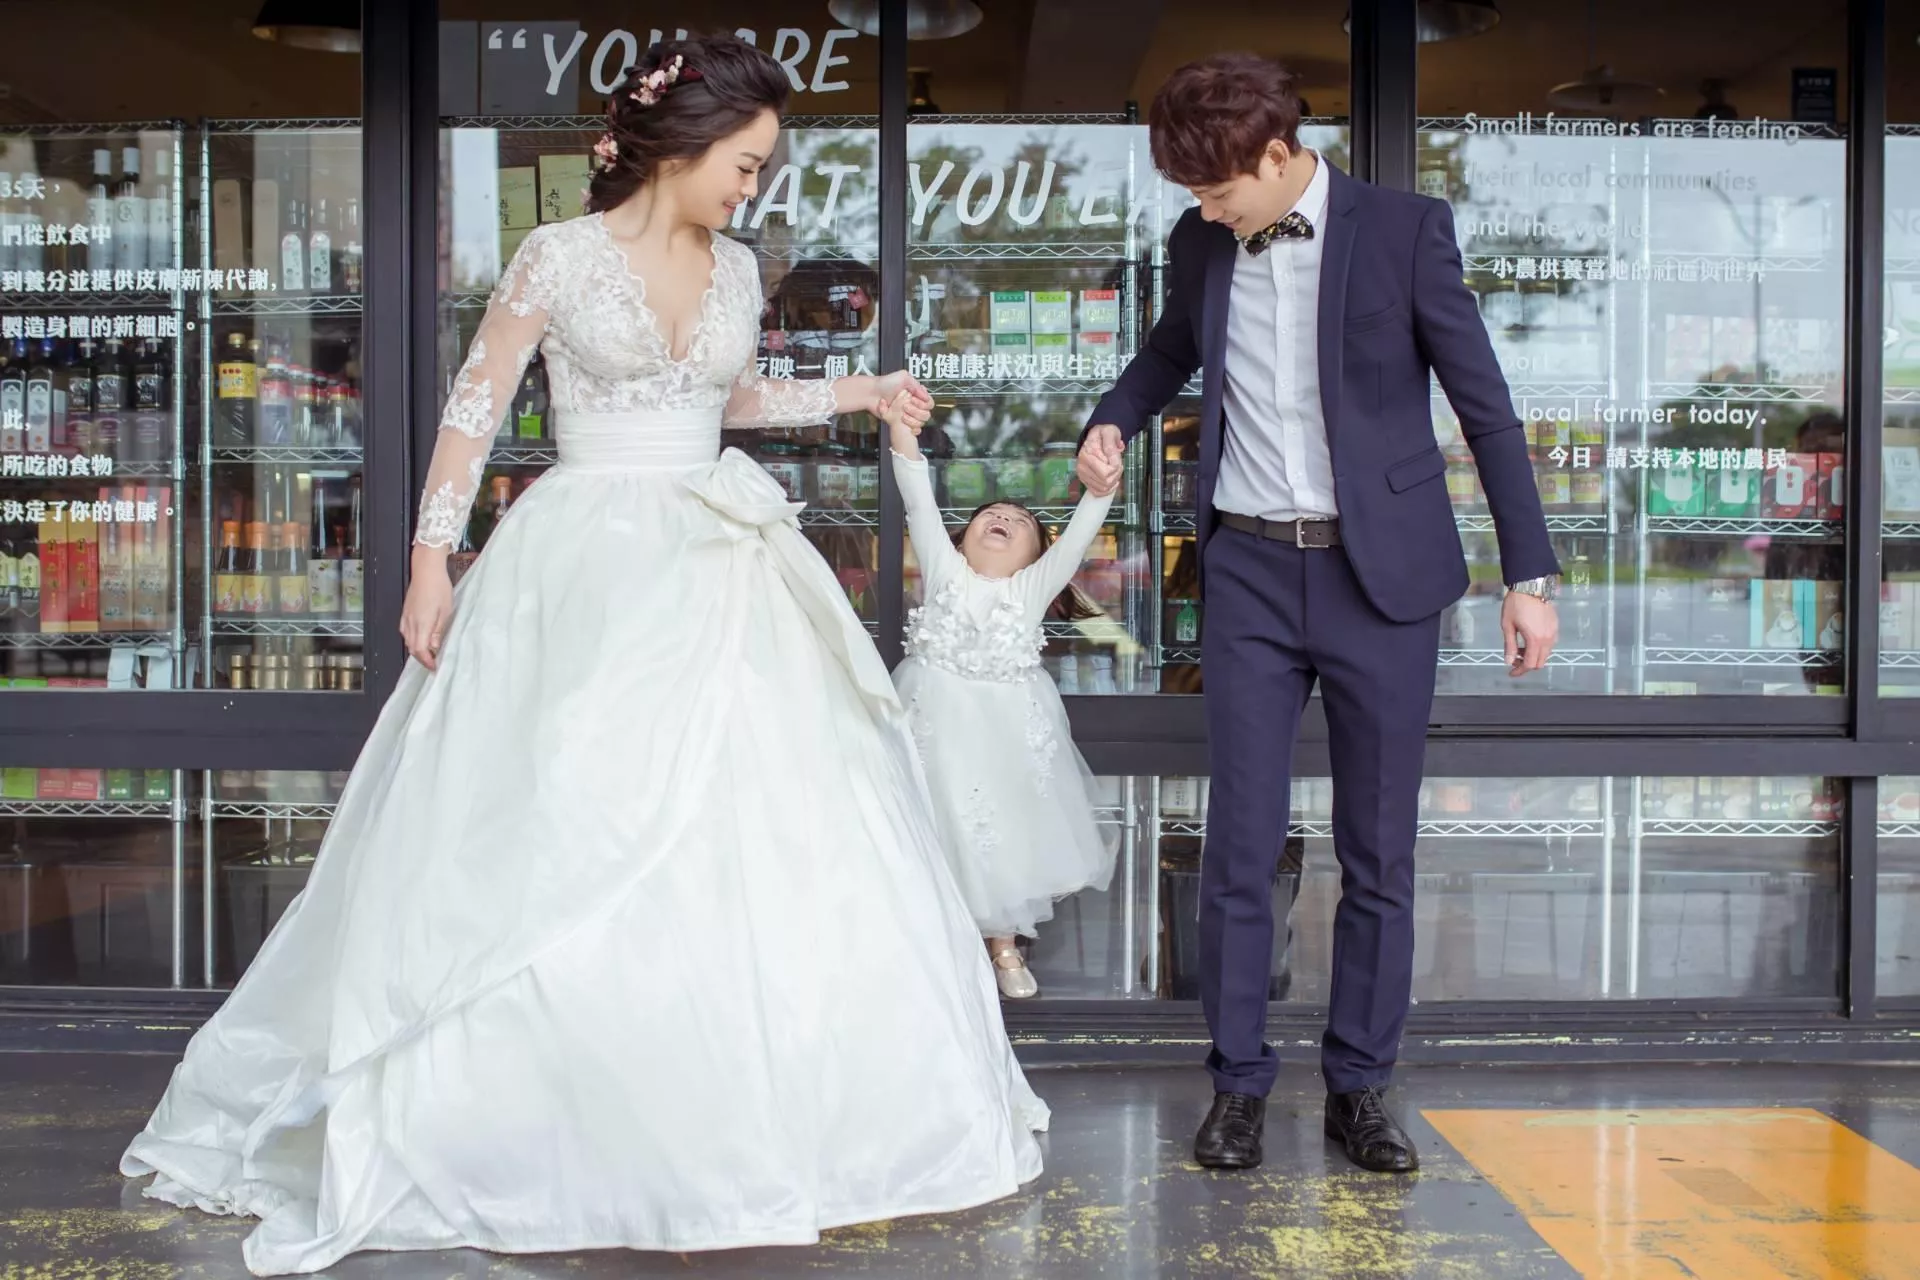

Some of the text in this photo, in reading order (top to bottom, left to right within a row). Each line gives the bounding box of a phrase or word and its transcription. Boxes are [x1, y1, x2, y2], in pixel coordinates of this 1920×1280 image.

[487, 28, 859, 95] “YO RE
[1464, 112, 1800, 146] Small farmers are feeding
[1464, 162, 1519, 187] their
[1533, 162, 1591, 188] local
[731, 163, 861, 229] AT
[908, 160, 1056, 226] YOU
[1464, 214, 1509, 236] and
[1524, 214, 1558, 237] the
[1523, 397, 1767, 429] local farmer today.
[0, 454, 113, 477] 所吃的食物
[1548, 446, 1787, 471] 今日 請支持本地的農民
[0, 501, 174, 523] 決定了你的健康。
